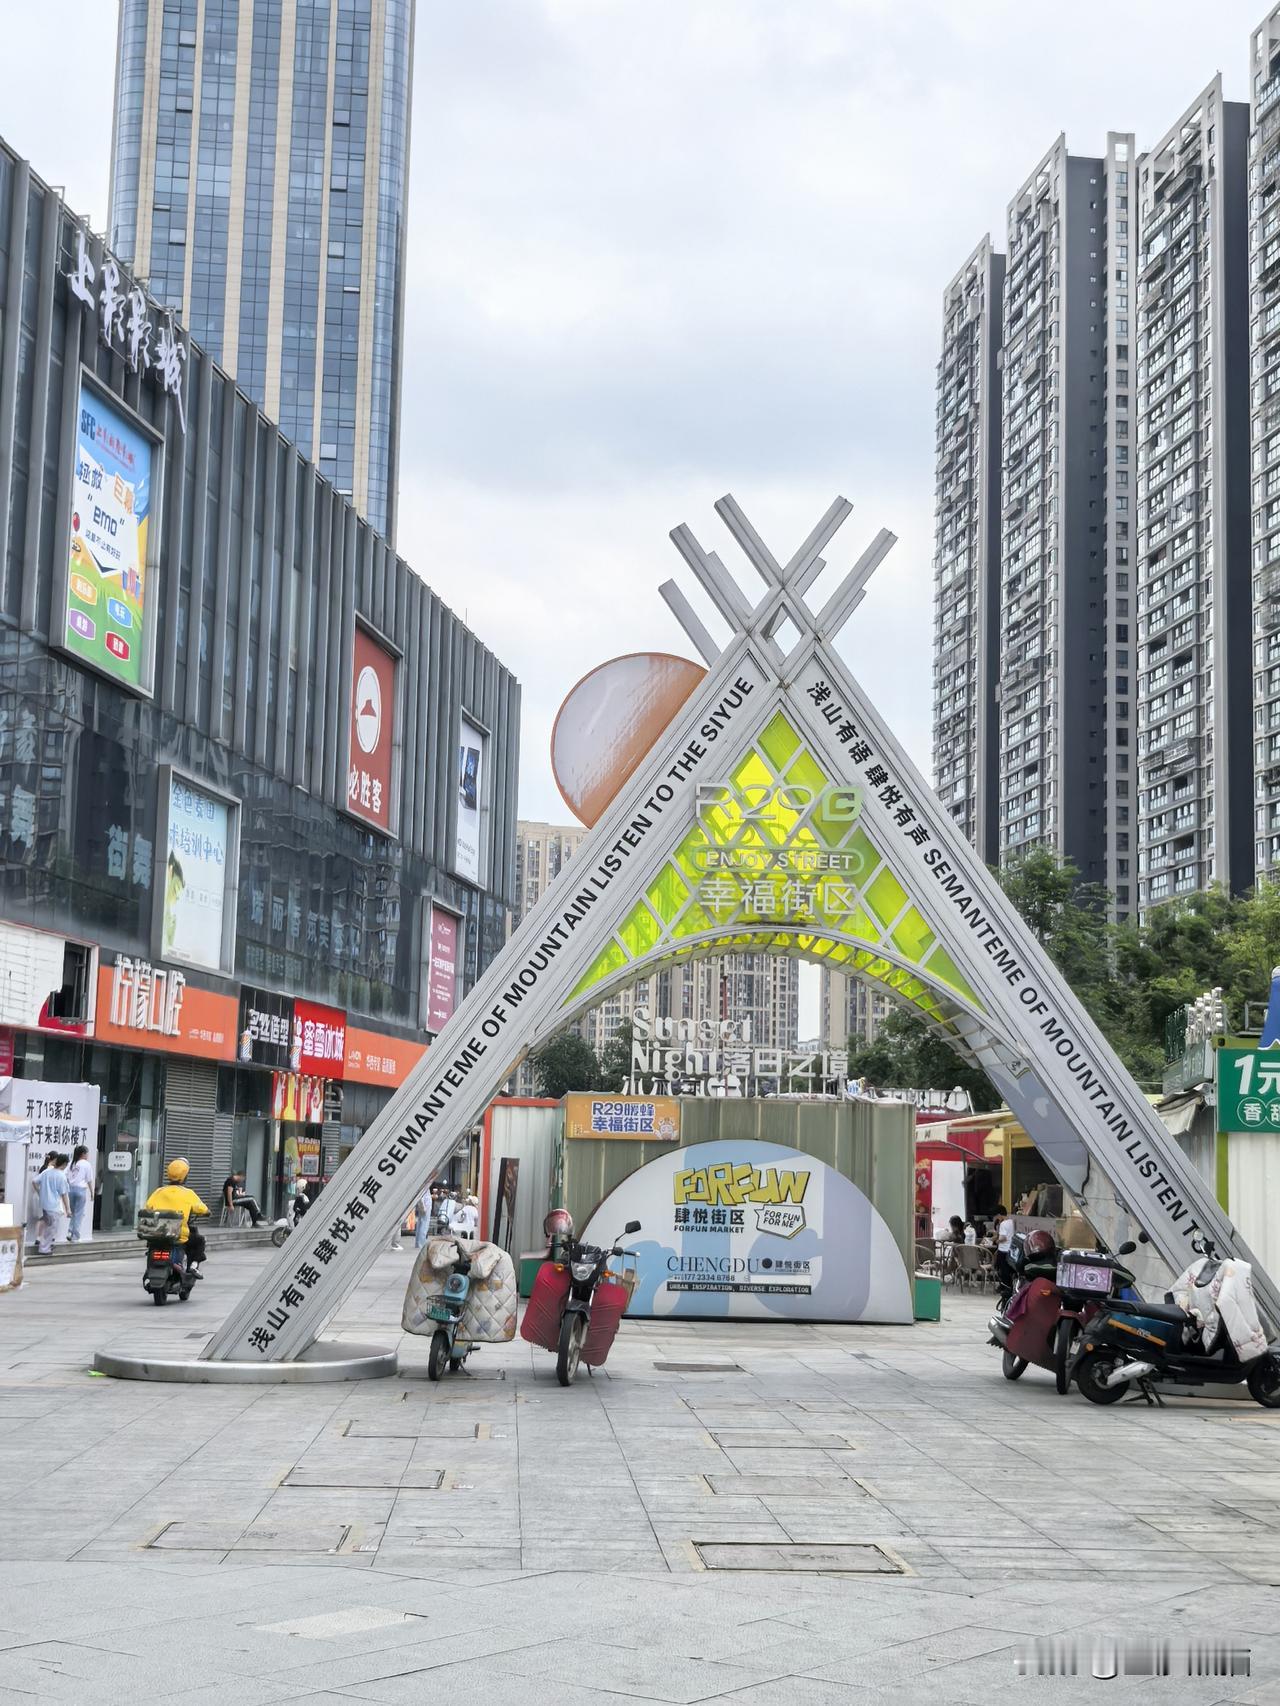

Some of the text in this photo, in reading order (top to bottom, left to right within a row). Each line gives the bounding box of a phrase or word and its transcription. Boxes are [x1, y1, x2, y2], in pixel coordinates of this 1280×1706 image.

[80, 408, 96, 441] SFC
[79, 461, 103, 490] 拯救
[348, 763, 382, 814] 必胜客
[706, 851, 854, 870] ENJOY STREET
[699, 877, 858, 916] 幸福街区
[806, 680, 874, 765] 浅山有语
[864, 763, 931, 846] 肆悦有声
[923, 848, 1027, 987] SEMANTEME
[1019, 986, 1049, 1016] OF
[1039, 1016, 1134, 1142] MOUNTAIN
[1124, 1141, 1190, 1222] LISTEN
[248, 1261, 322, 1353] 浅山有语
[313, 1176, 383, 1266] 肆悦有声
[377, 1036, 488, 1177] SEMANTEME
[481, 1004, 508, 1038] OF
[502, 887, 598, 1008] MOUNTAIN
[590, 813, 653, 890] LISTEN
[643, 783, 674, 814] TO
[667, 739, 708, 782] THE
[700, 676, 755, 742] SIYUE
[633, 1007, 752, 1042] Sunset
[302, 1019, 345, 1061] 蜜雪冰城
[632, 1040, 849, 1081] Night 落日之境
[26, 1099, 73, 1120] 开了15家店
[592, 1116, 654, 1132] 幸福街区
[673, 1161, 811, 1207] FORFUN
[673, 1224, 745, 1234] FORFUN MARKET
[674, 1207, 745, 1226] 肆悦街区
[763, 1209, 800, 1223] FOR FUN
[763, 1217, 795, 1229] FOR ME
[667, 1255, 759, 1274] CHENGDU
